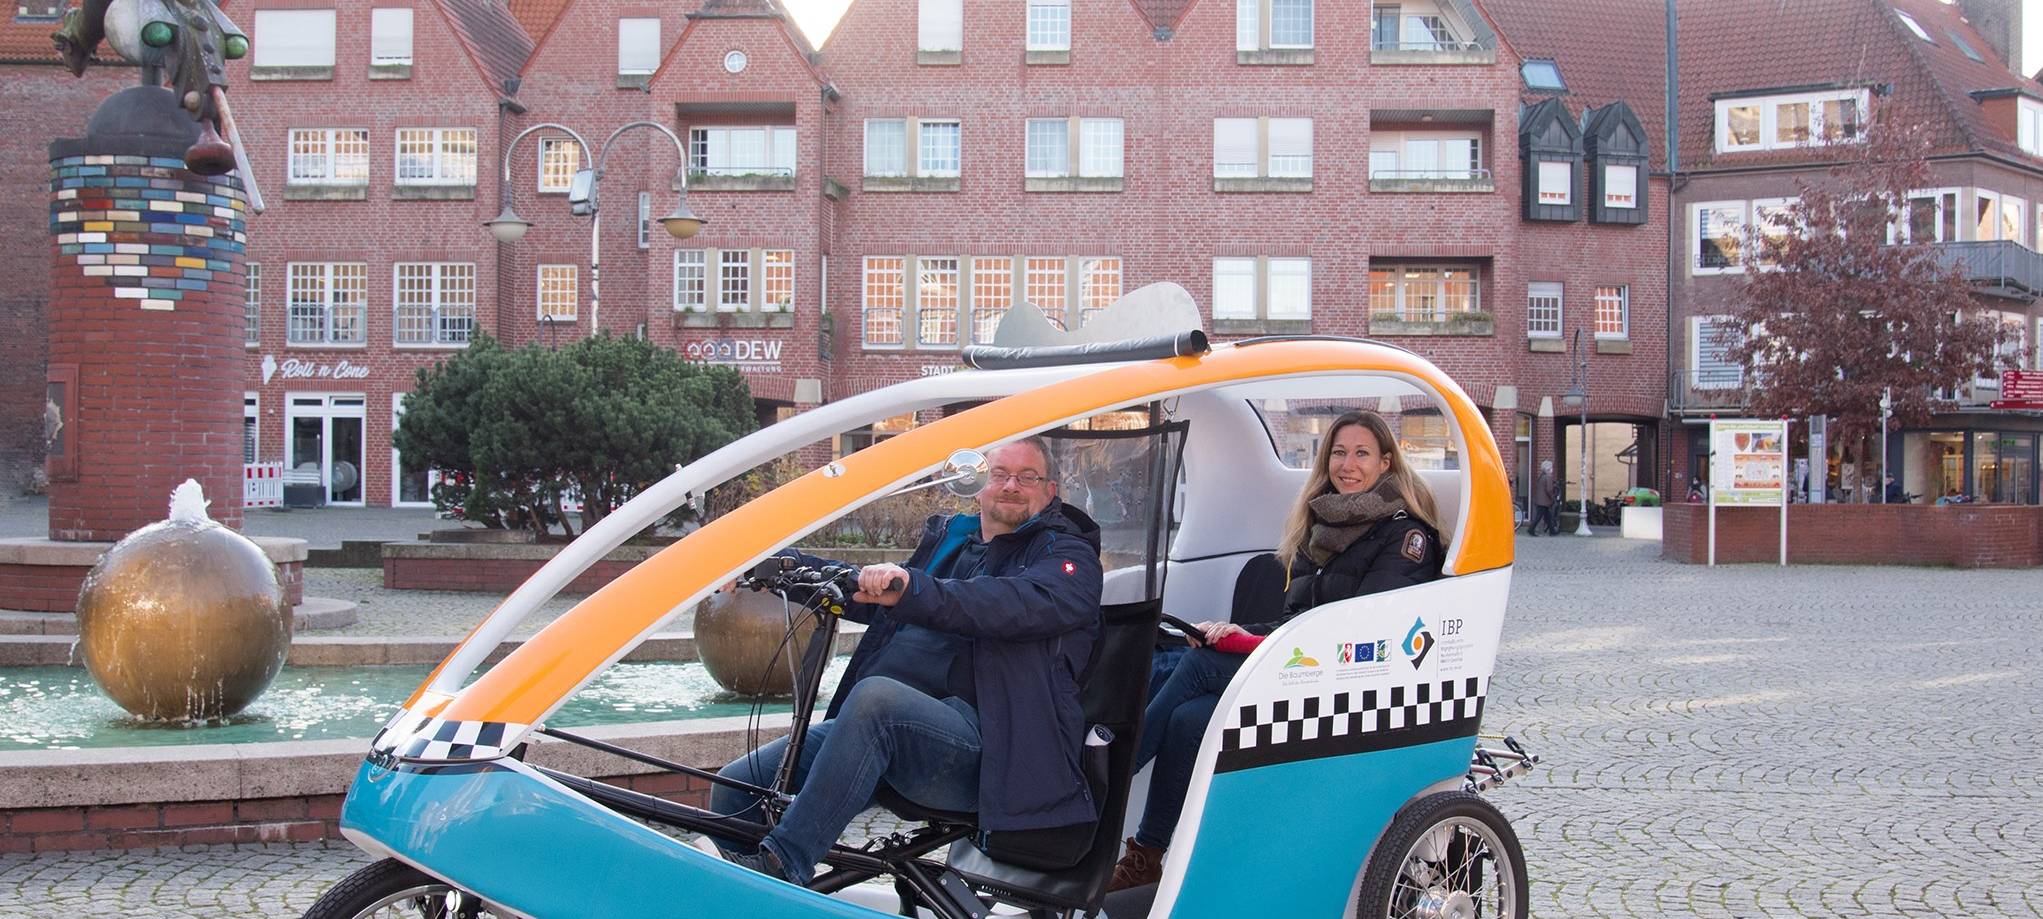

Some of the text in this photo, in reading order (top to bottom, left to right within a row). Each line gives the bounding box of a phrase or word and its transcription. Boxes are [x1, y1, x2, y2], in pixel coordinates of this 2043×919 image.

[735, 340, 782, 360] DEW
[281, 359, 370, 379] Roll n Cone
[1442, 618, 1463, 635] IBP
